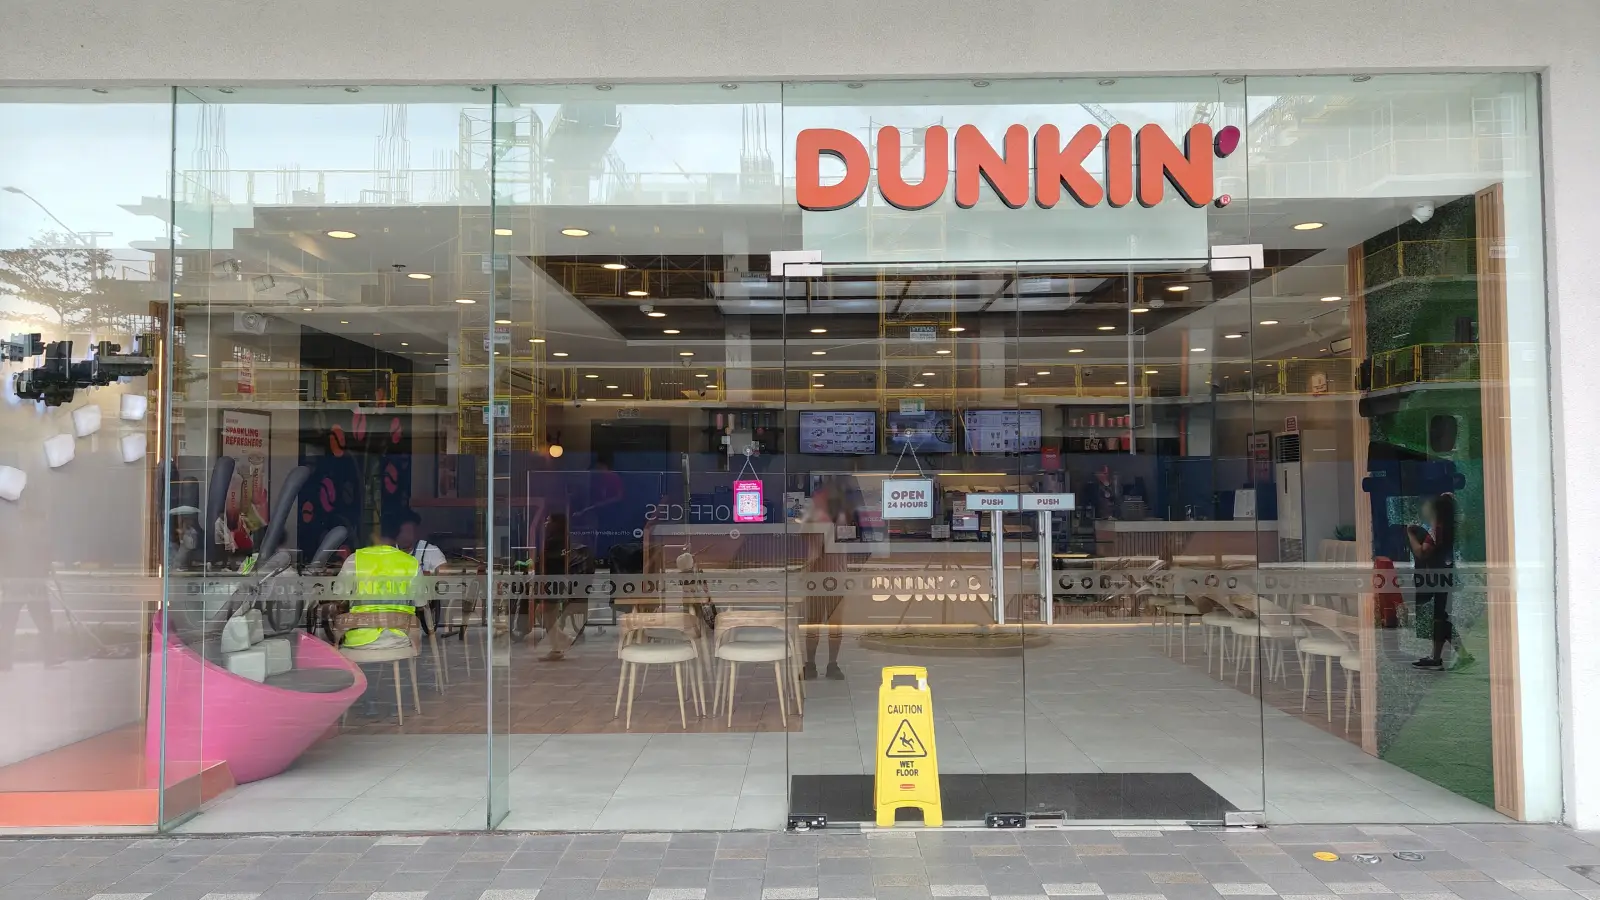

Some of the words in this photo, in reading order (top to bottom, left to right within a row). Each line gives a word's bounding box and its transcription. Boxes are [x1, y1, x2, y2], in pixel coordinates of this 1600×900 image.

[796, 123, 1241, 211] DUNKIN'
[225, 435, 263, 448] REFRESHERS
[890, 490, 925, 500] OPEN
[887, 501, 899, 509] 24
[900, 501, 928, 509] HOURS
[981, 498, 1004, 506] PUSH
[1037, 498, 1060, 506] PUSH
[887, 704, 923, 714] CAUTION
[899, 760, 915, 769] WET
[896, 768, 919, 777] FLOOR
